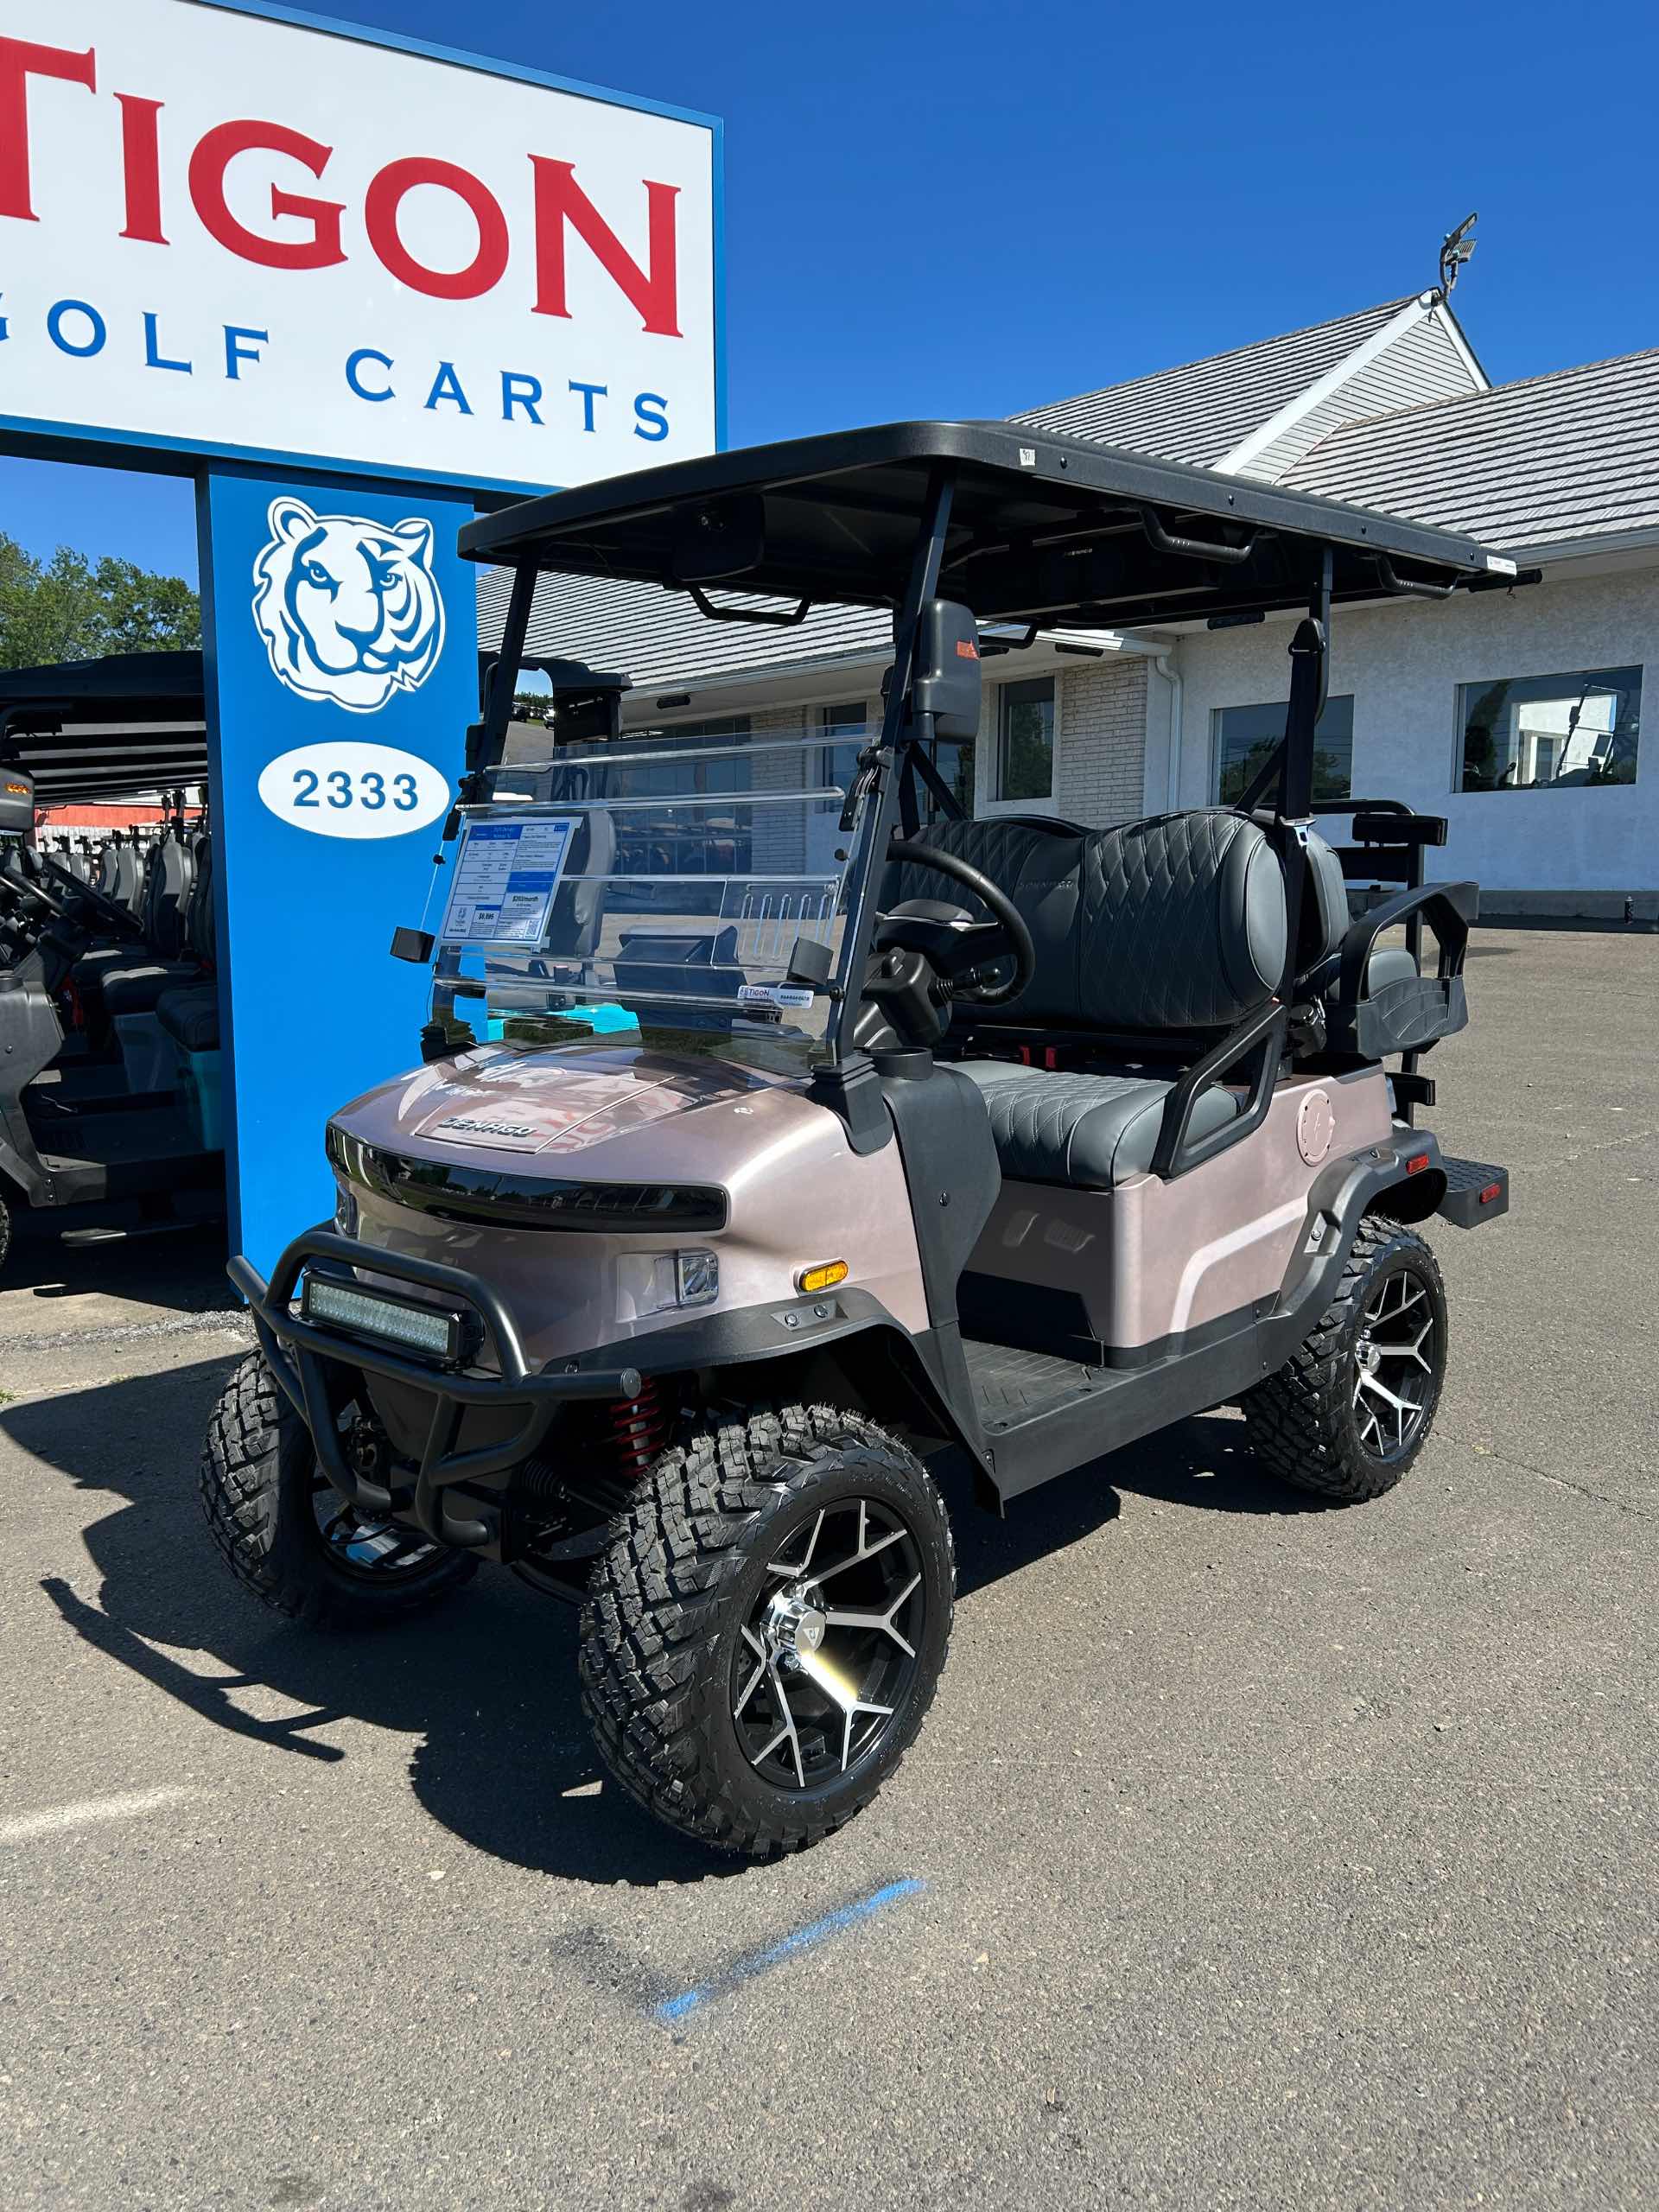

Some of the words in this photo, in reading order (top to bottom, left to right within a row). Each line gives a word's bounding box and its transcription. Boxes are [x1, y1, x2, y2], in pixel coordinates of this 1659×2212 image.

[0, 36, 684, 339] TIGON
[0, 292, 270, 380] OLF
[346, 348, 670, 442] CARTS
[293, 769, 419, 811] 2333
[748, 988, 770, 996] TIGON
[438, 1117, 537, 1138] DENAGO
